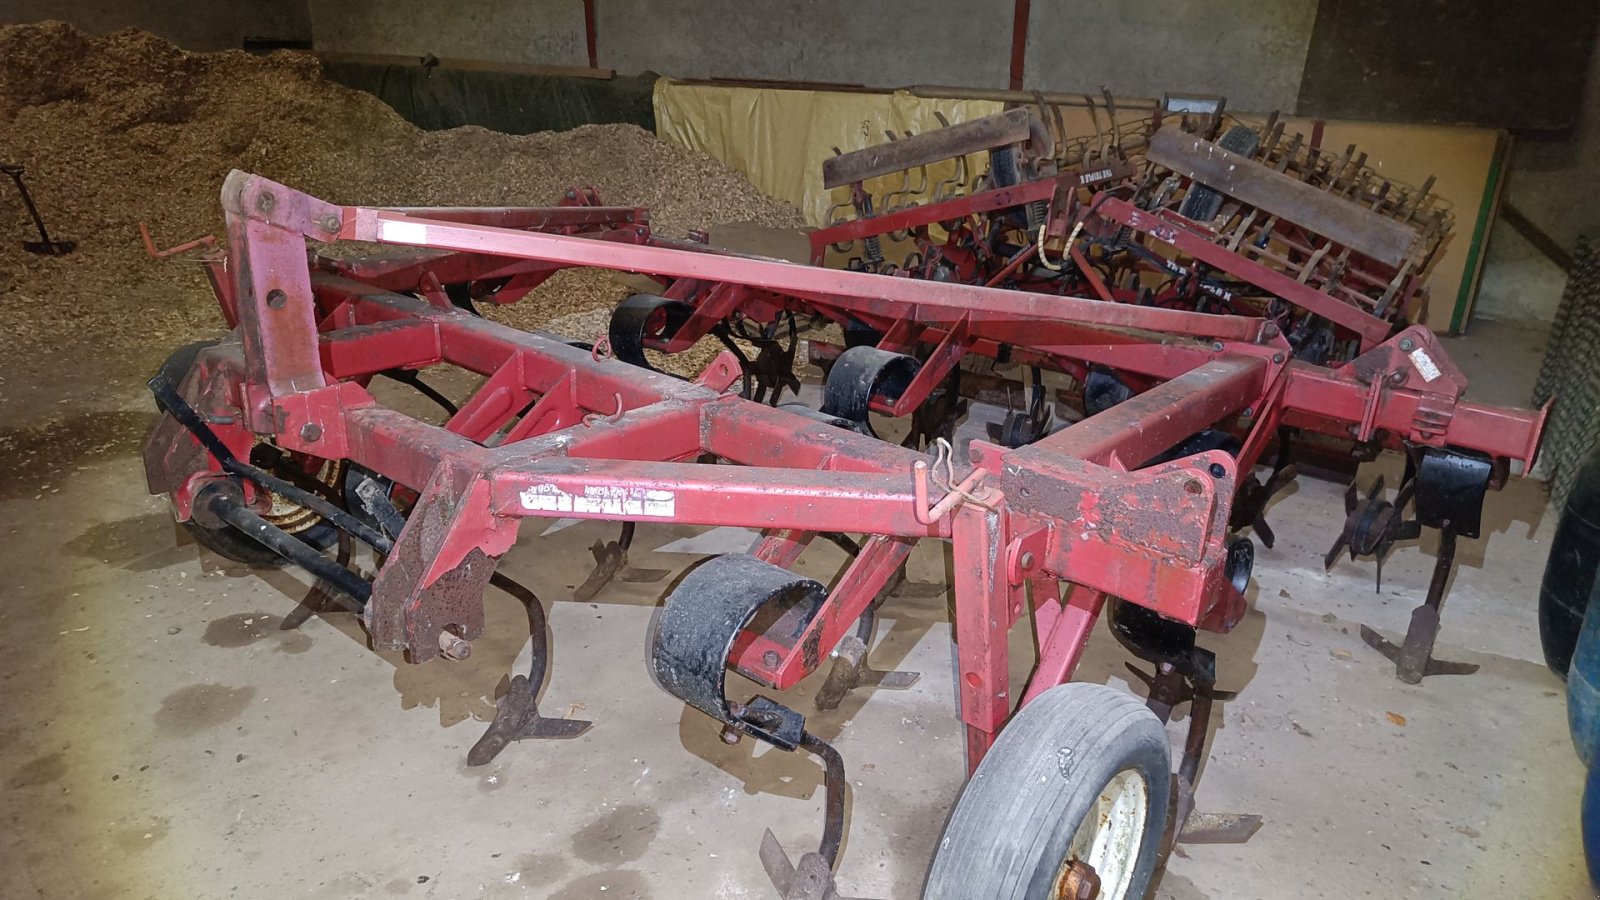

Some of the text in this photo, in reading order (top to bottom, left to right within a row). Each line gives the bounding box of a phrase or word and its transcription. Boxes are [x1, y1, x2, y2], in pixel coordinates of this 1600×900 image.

[1080, 169, 1113, 184] THE TRIPLE K
